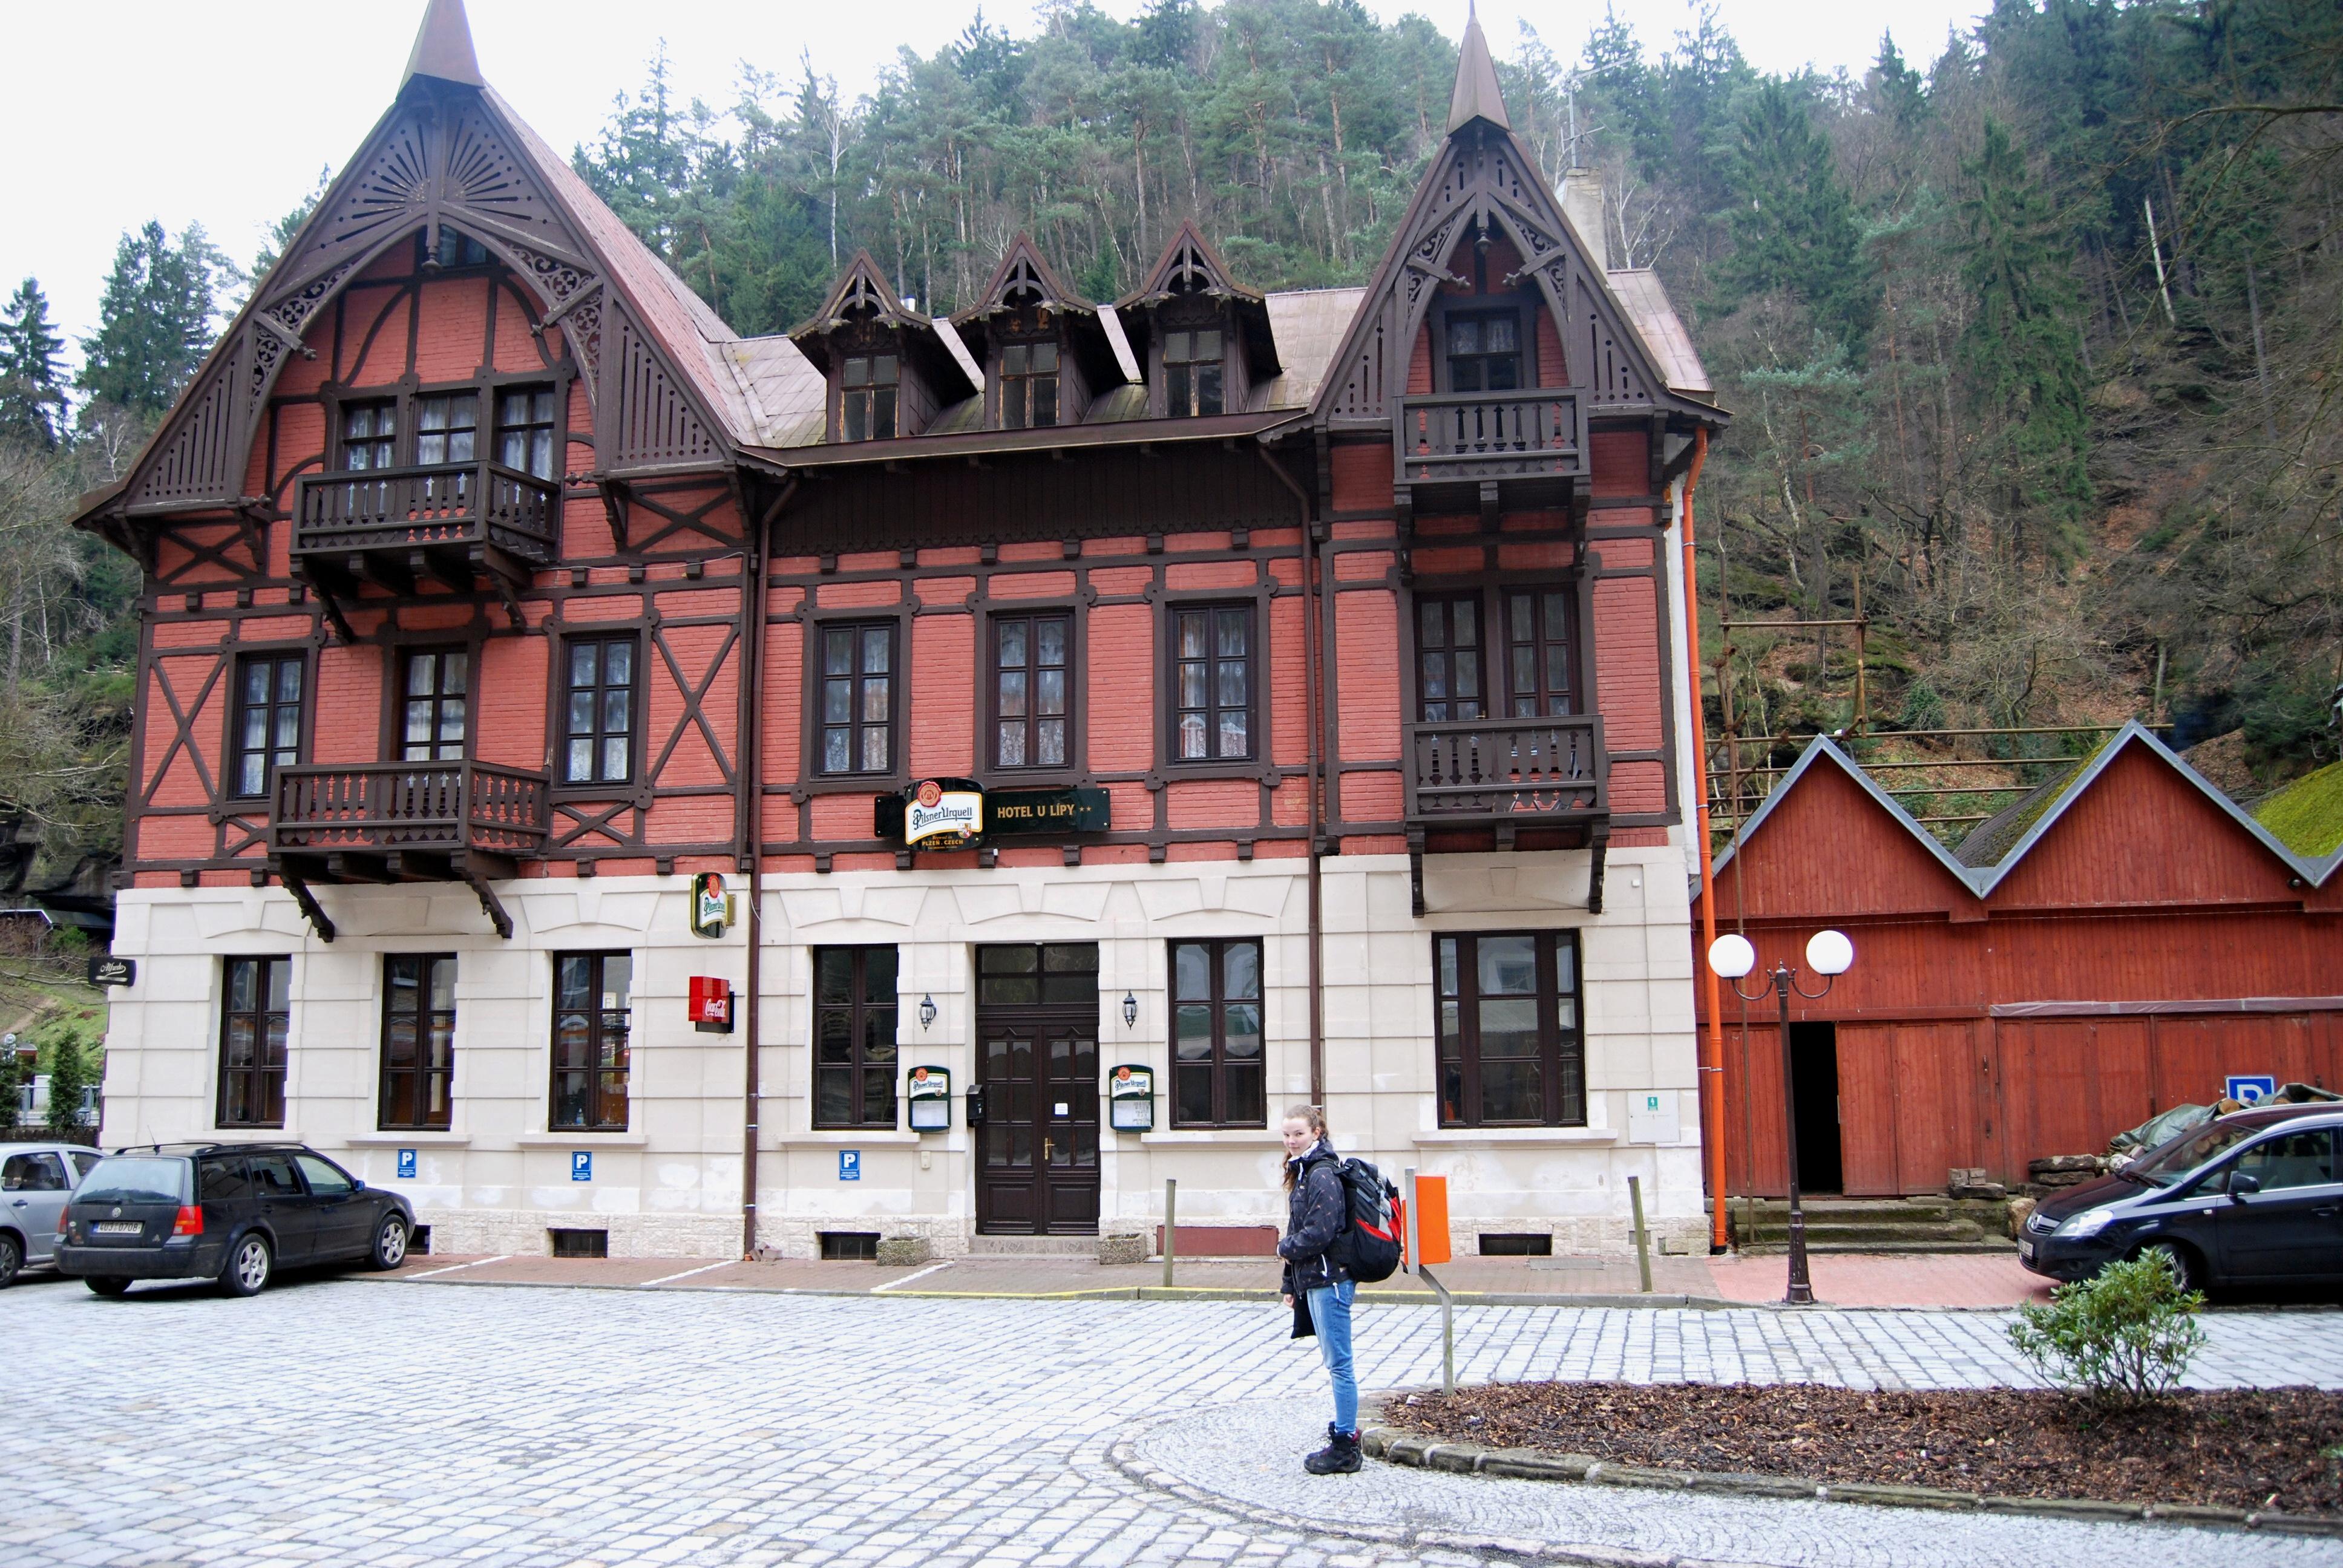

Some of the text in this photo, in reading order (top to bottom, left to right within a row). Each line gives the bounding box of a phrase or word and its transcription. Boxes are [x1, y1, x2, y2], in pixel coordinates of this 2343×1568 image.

[913, 806, 972, 830] Pilsner Urquell
[997, 803, 1075, 818] HOTEL U LÍPY
[100, 962, 126, 975] Alfredo
[402, 1152, 413, 1166] P
[577, 1154, 588, 1169] P
[844, 1153, 856, 1168] P
[119, 1223, 139, 1232] 0708
